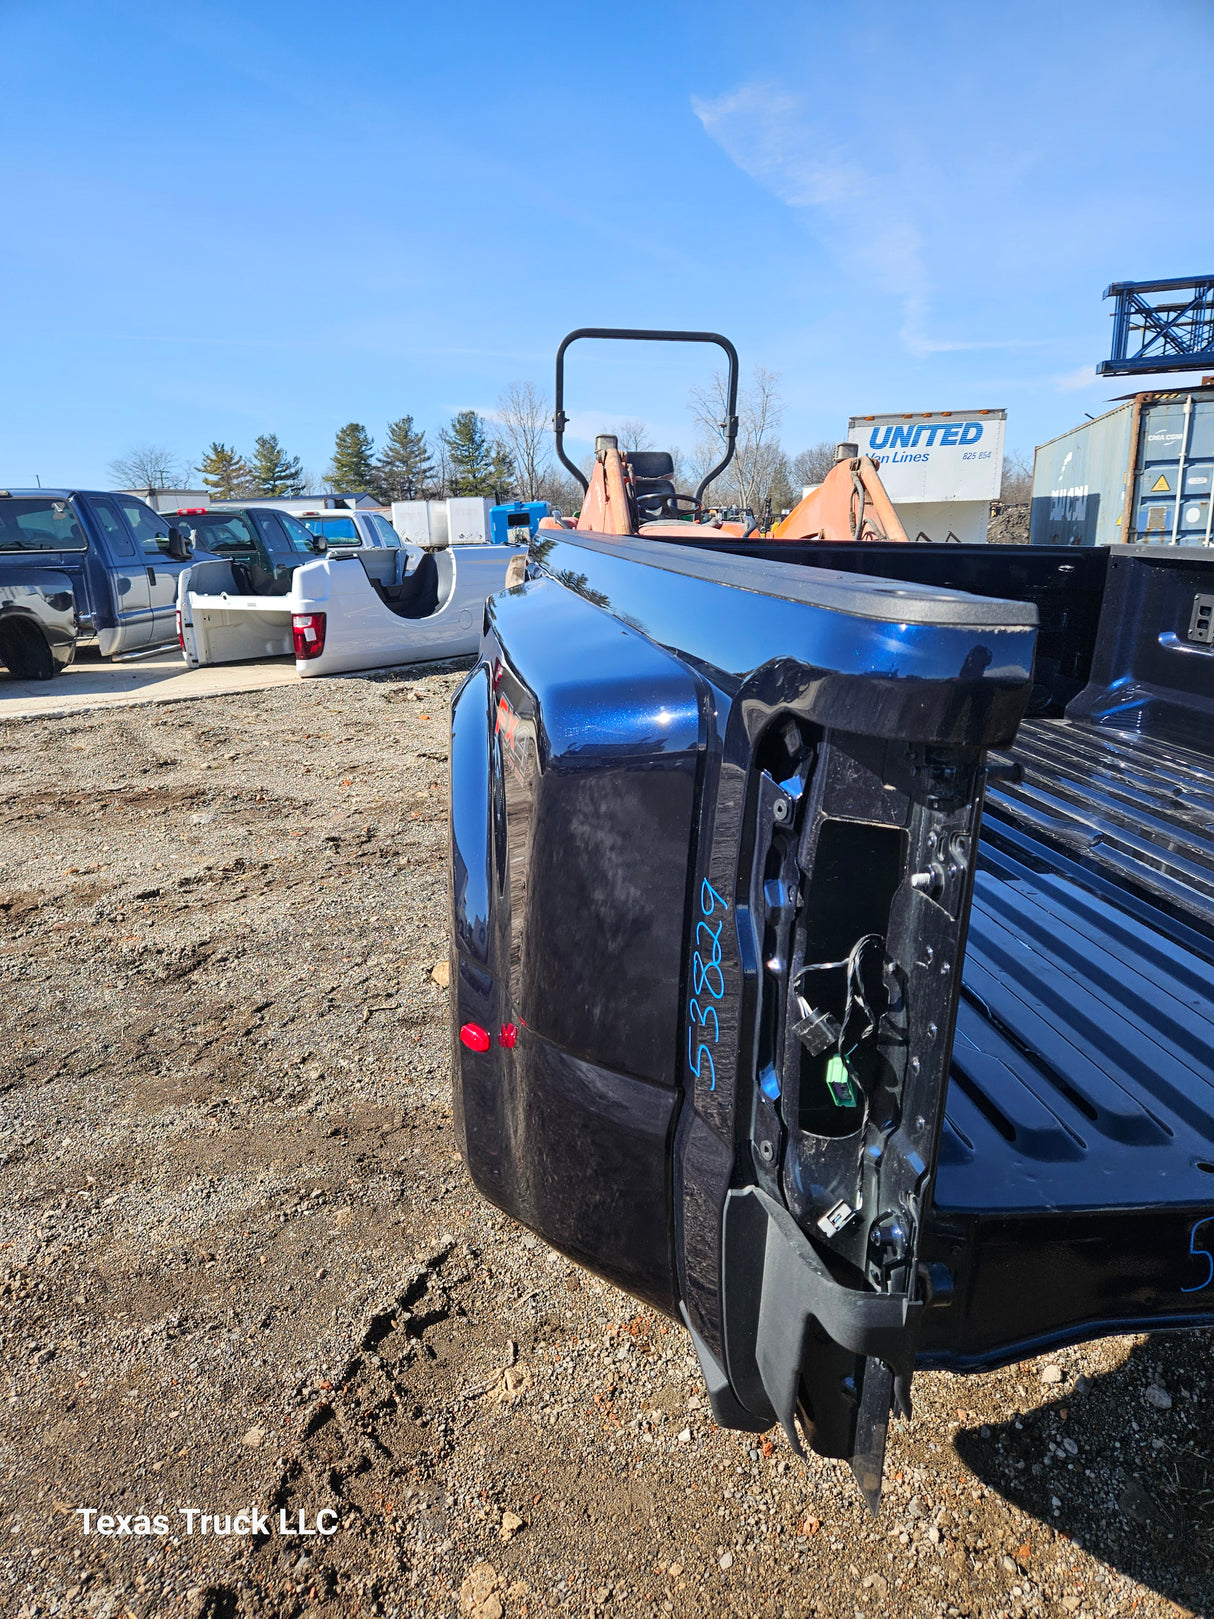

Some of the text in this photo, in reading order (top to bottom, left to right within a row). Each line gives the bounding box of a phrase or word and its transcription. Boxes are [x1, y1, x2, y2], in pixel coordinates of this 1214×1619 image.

[869, 422, 984, 450] UNITED
[892, 451, 930, 463] Lines
[962, 451, 992, 460] 825 854
[689, 877, 728, 1091] 53829
[1180, 1216, 1214, 1293] 5
